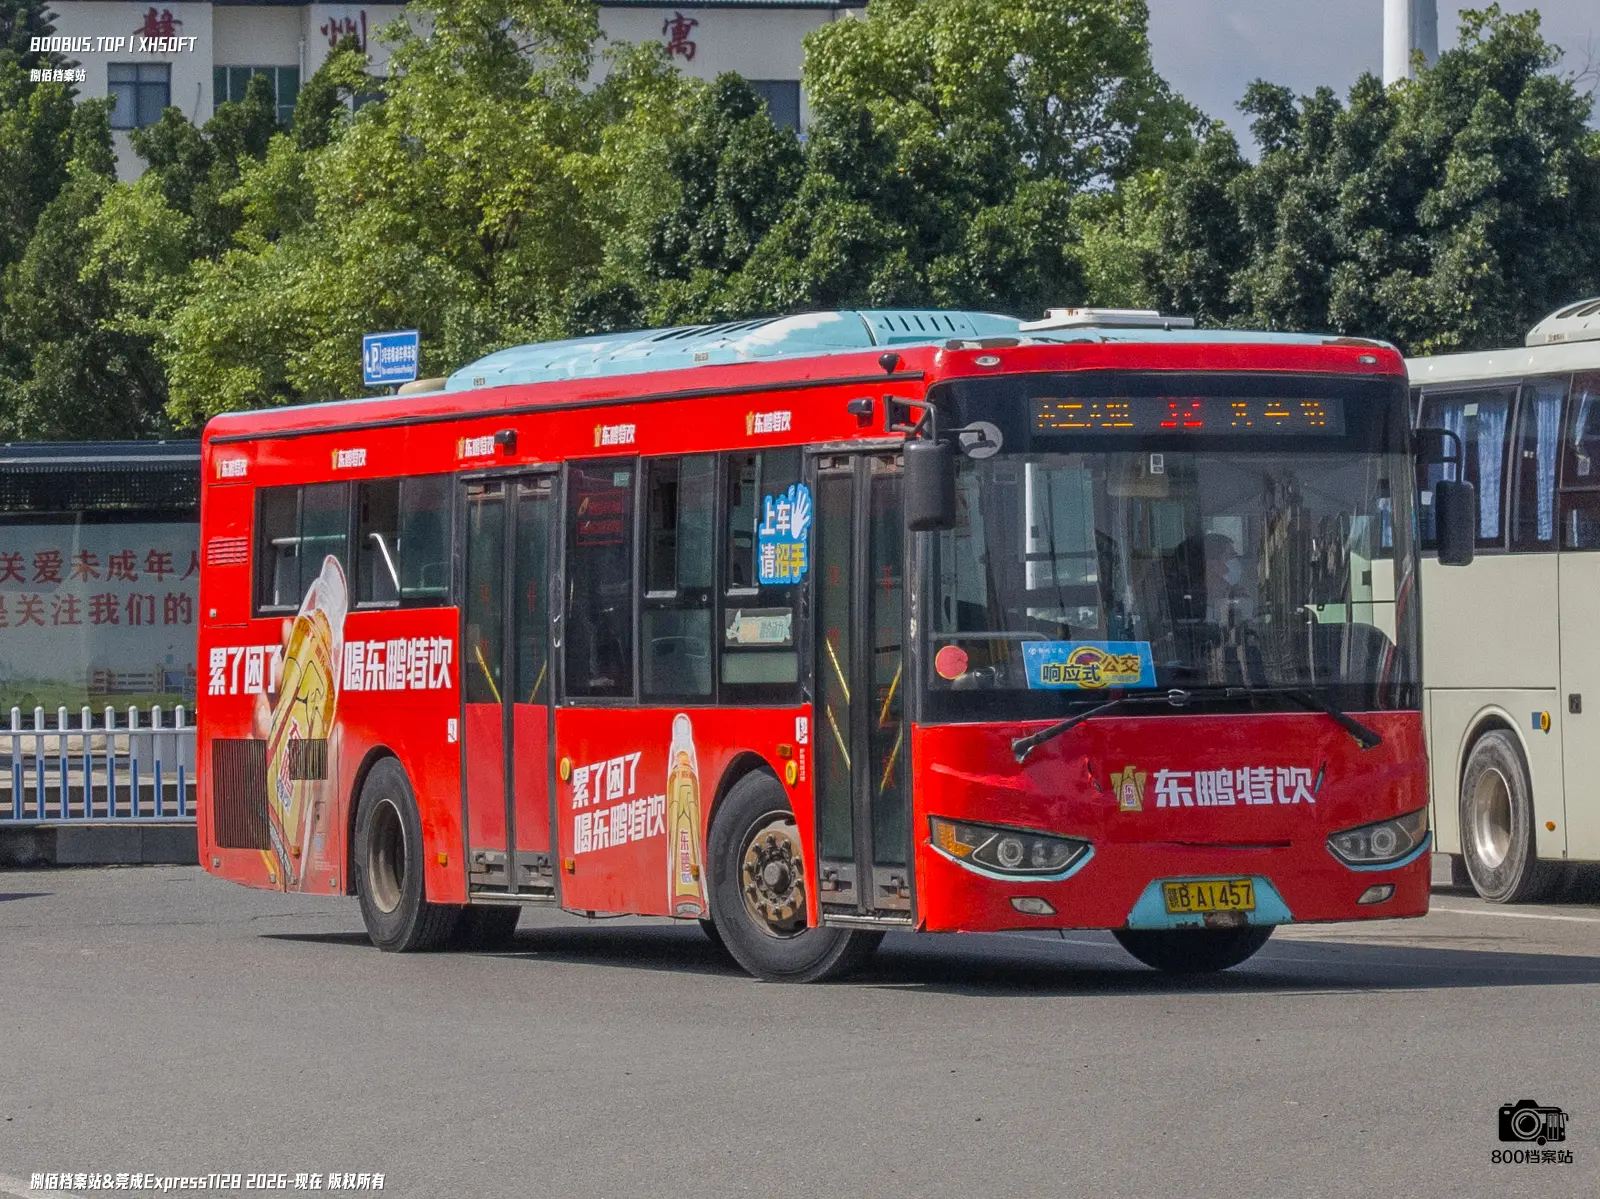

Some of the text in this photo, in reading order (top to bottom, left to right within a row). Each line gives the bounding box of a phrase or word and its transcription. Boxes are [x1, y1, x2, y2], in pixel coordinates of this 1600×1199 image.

[760, 500, 791, 536] 上车
[761, 543, 805, 578] 请招手
[0, 592, 193, 627] 关注我们的
[208, 645, 283, 695] 累了困了
[343, 636, 452, 691] 喝东鹏特饮
[572, 752, 641, 809] 累了困了
[1153, 766, 1316, 808] 东鹏特饮
[574, 795, 666, 855] 喝东鹏特饮
